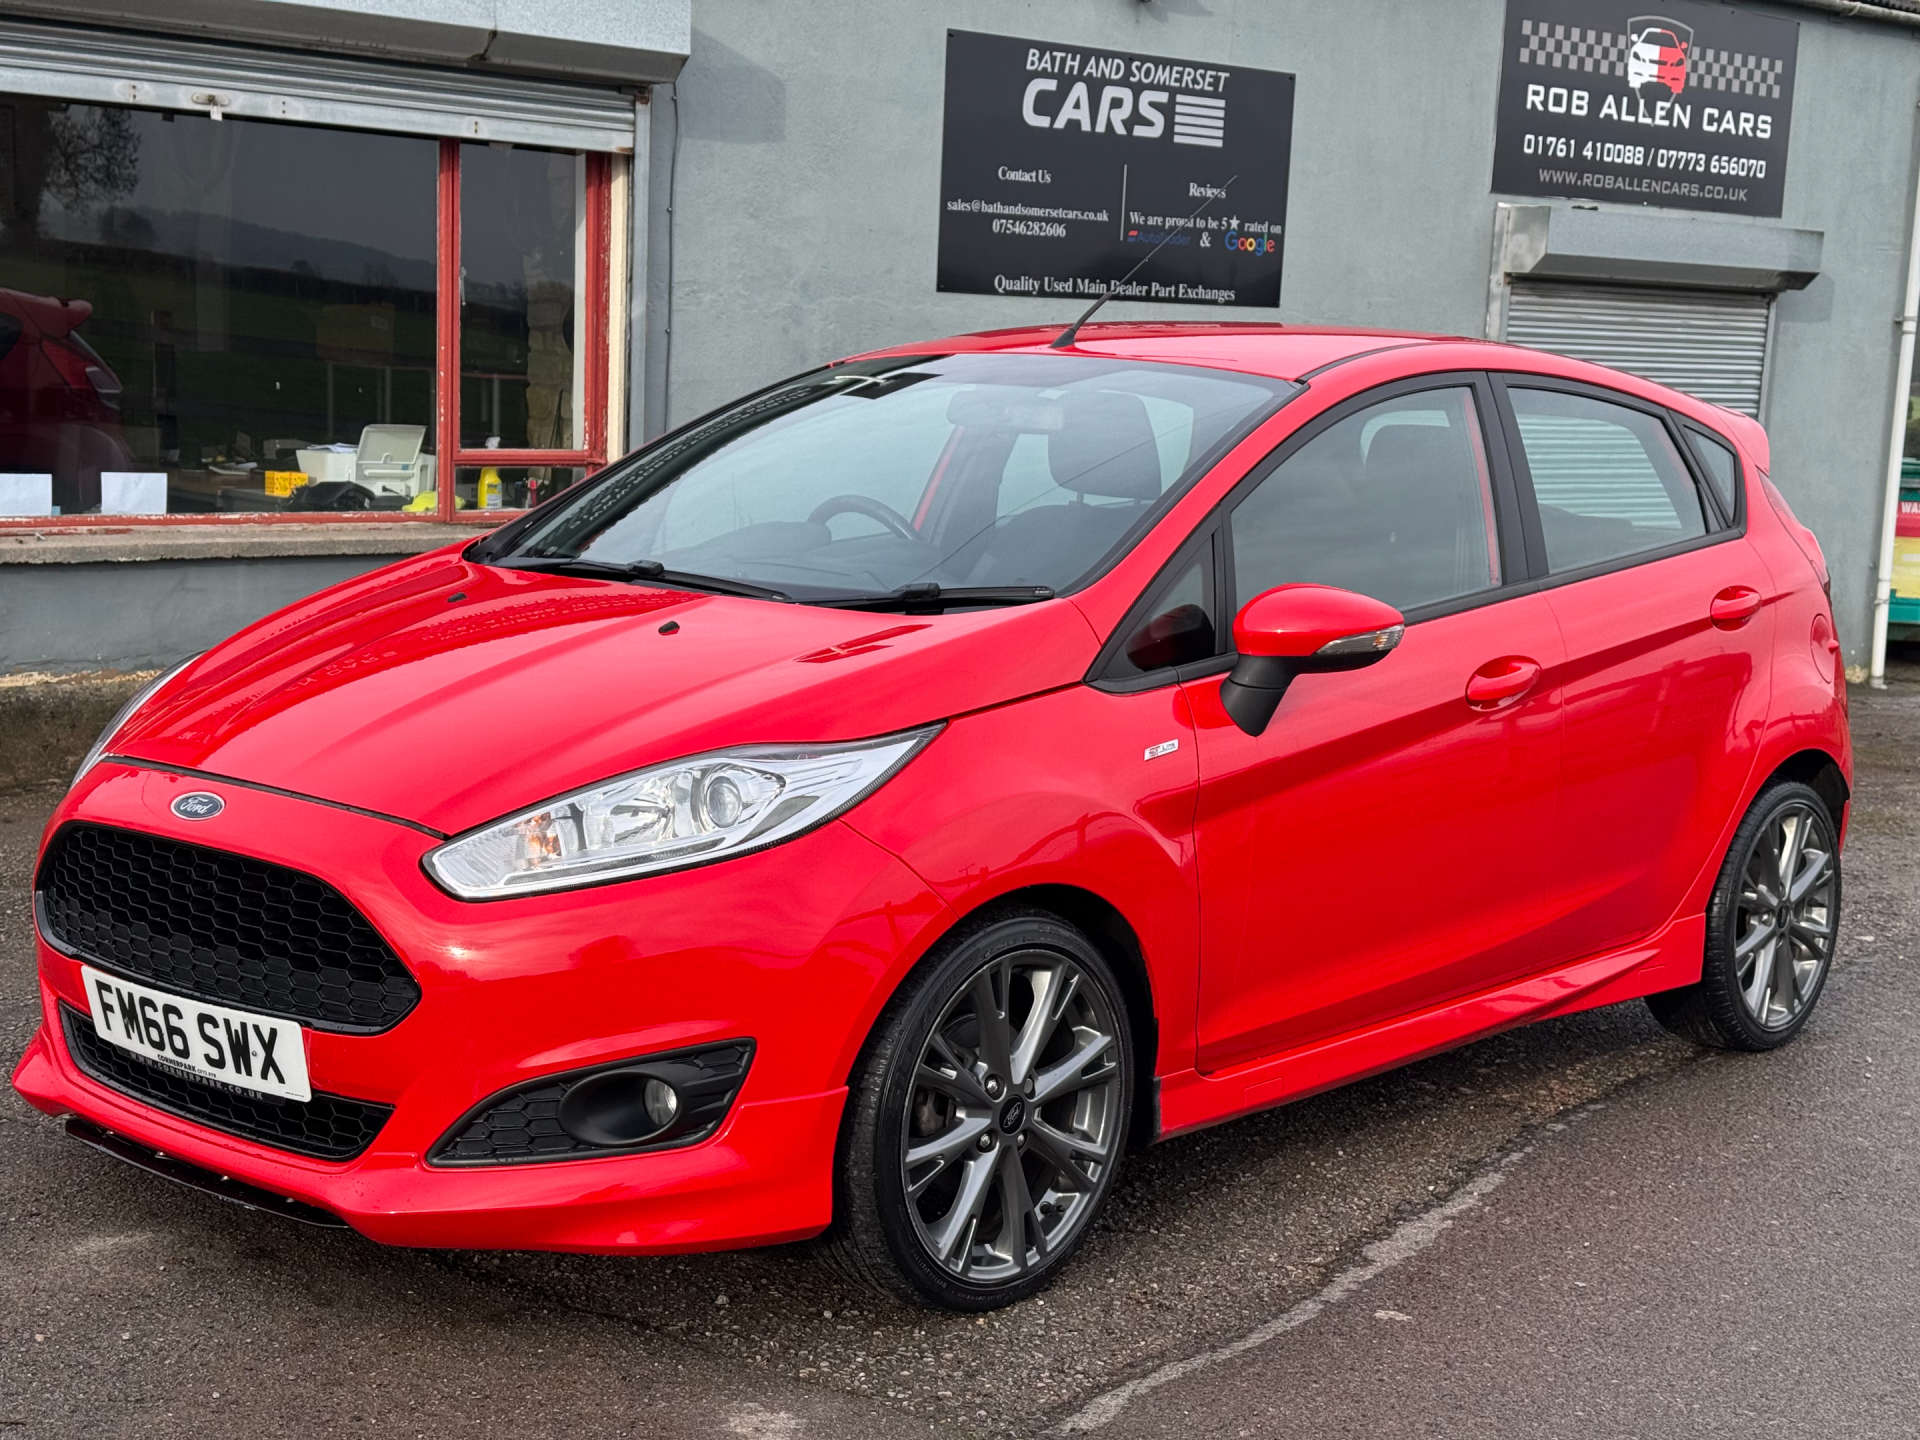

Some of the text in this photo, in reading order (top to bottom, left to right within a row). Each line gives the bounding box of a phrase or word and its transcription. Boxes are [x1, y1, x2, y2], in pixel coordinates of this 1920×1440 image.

[1025, 48, 1230, 92] BATH AND SOMERSET
[1022, 77, 1170, 138] CARS
[1526, 84, 1773, 139] ROB ALLEN CARS
[1523, 134, 1767, 179] 01761 410088 / 07773 656070
[998, 166, 1051, 184] Contact Us
[1539, 168, 1748, 201] WWW.ROBALLENCARS.CO.UK
[1189, 182, 1226, 198] Reviews
[947, 199, 1109, 222] sales@bathandsomersetcars.co.uk
[1129, 211, 1282, 234] We are proud to be 5 rated on
[992, 219, 1066, 237] 07546282606
[1137, 229, 1275, 256] AutoTader & Google
[994, 274, 1235, 303] Quality Used Main Dealer Part Exchanges
[1901, 502, 1920, 513] WA
[180, 796, 213, 814] Ford
[95, 979, 286, 1085] FM66 SWX
